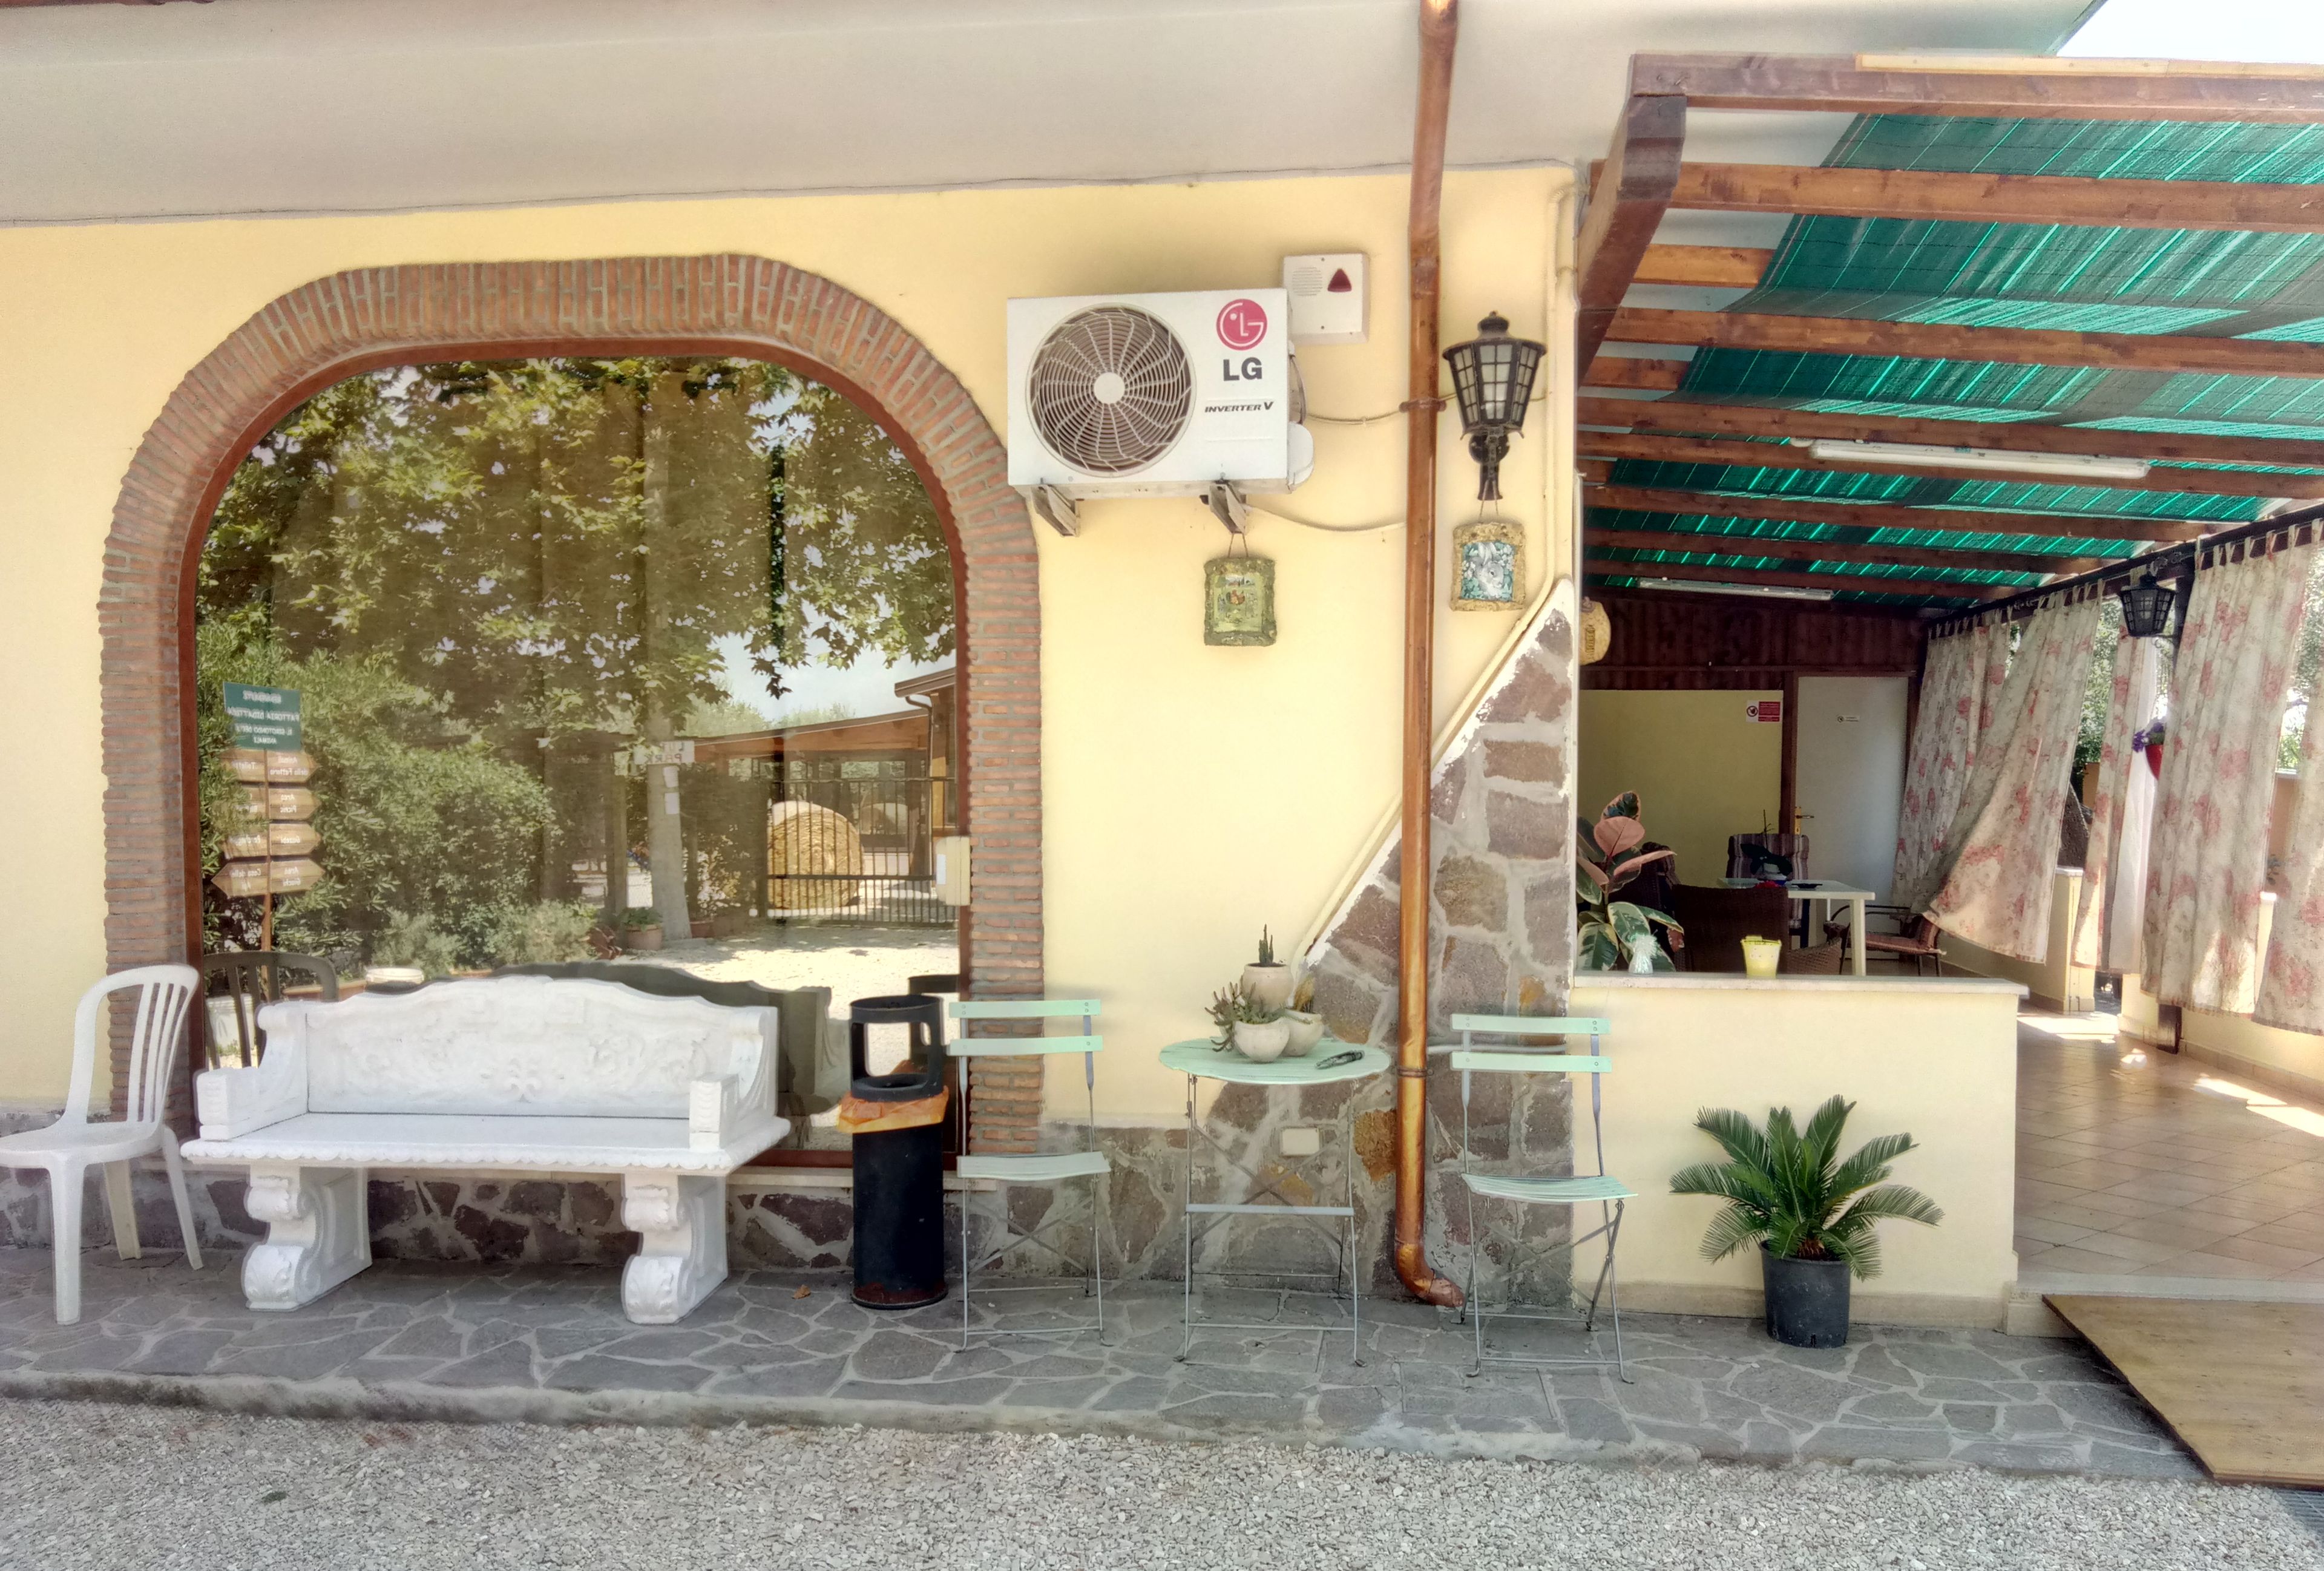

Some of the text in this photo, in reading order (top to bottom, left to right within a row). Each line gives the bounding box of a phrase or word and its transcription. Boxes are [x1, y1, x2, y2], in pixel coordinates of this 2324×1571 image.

[1223, 356, 1262, 381] LG
[1204, 401, 1274, 413] INVERTER V
